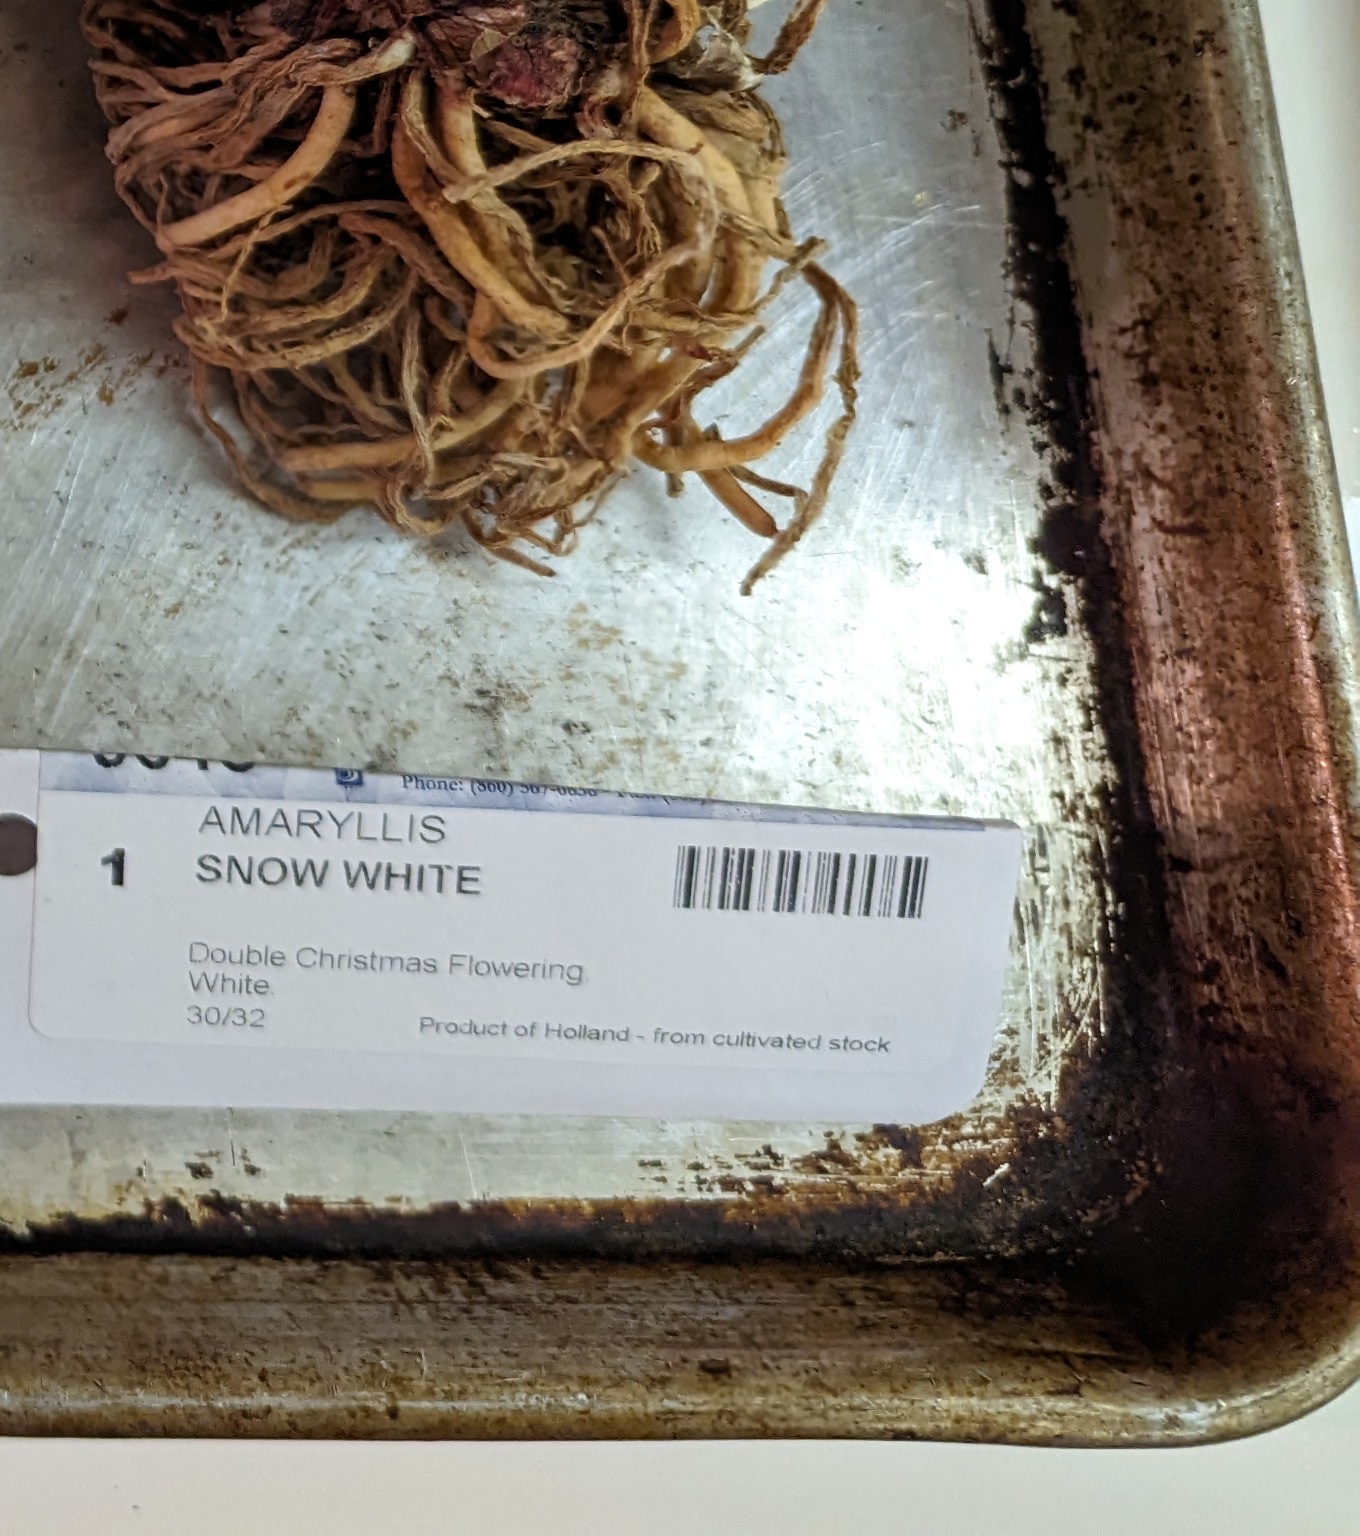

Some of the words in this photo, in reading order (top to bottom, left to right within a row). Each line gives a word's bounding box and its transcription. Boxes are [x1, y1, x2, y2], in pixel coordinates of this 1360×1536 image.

[199, 806, 446, 844] AMARYLLIS
[102, 848, 125, 887] 1
[196, 854, 329, 888] SNOW
[343, 860, 480, 895] WHITE
[189, 942, 287, 968] Double
[296, 947, 439, 975] Christmas
[187, 1005, 265, 1029] 30/32
[419, 1016, 508, 1037] Product
[514, 1021, 538, 1038] of
[545, 1023, 631, 1042] Holland
[653, 1027, 706, 1045] from
[712, 1031, 822, 1050] cultivated
[829, 1036, 890, 1053] stock
